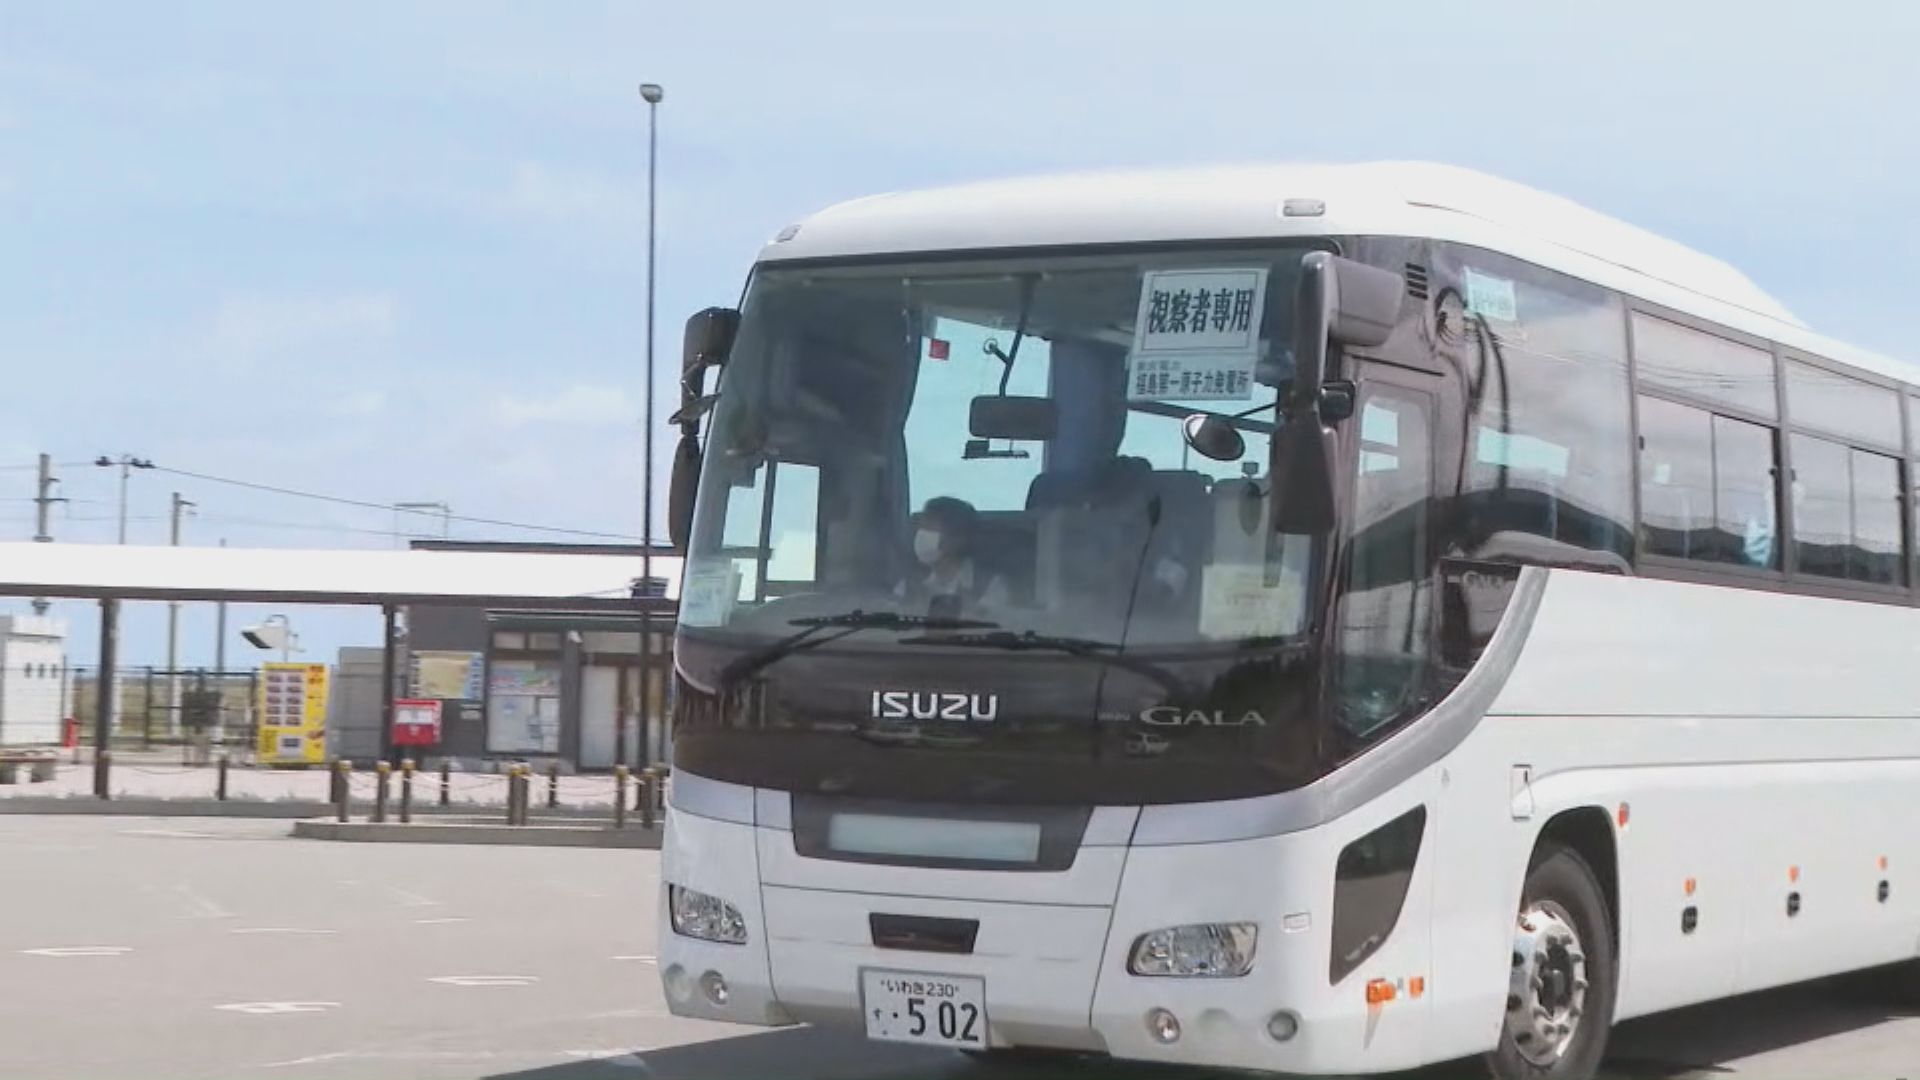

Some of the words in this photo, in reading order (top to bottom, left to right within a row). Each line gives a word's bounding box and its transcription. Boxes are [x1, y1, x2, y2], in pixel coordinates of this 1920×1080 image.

[1148, 287, 1254, 334] 視察者専用
[872, 690, 998, 722] ISUZU
[1139, 705, 1267, 726] GALA
